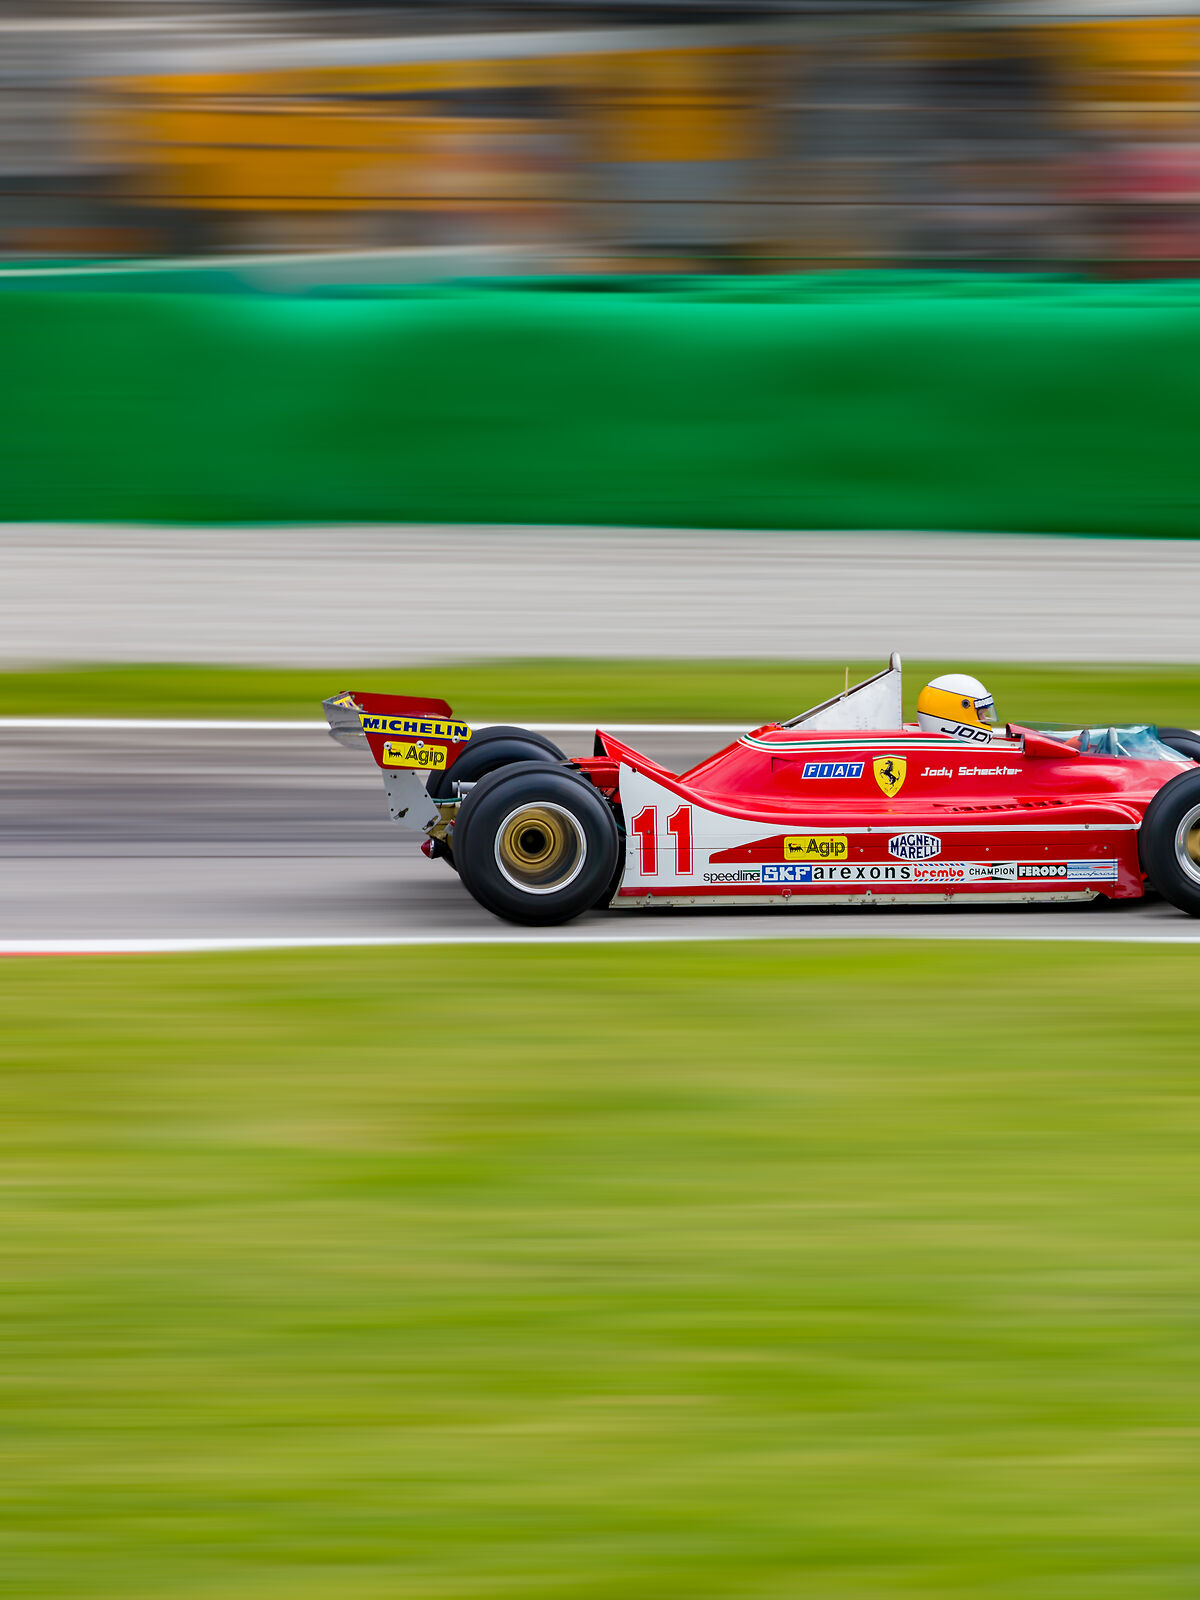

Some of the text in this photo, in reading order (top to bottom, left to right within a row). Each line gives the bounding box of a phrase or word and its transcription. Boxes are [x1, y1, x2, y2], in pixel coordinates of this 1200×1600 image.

[363, 717, 468, 737] MICHELIN
[940, 725, 994, 744] JODY
[405, 745, 445, 766] Agip
[808, 765, 859, 776] FIAT
[921, 767, 1023, 778] Jody Scheckter
[631, 805, 693, 876] 11
[806, 838, 846, 857] Agip
[890, 834, 940, 851] MAGNETI
[890, 843, 940, 859] MARELLI
[703, 869, 760, 883] speedline
[763, 866, 811, 881] SKF
[813, 866, 911, 880] arexons
[914, 867, 964, 877] brembo
[969, 868, 1015, 876] CHAMPION
[1018, 866, 1067, 876] FERODO
